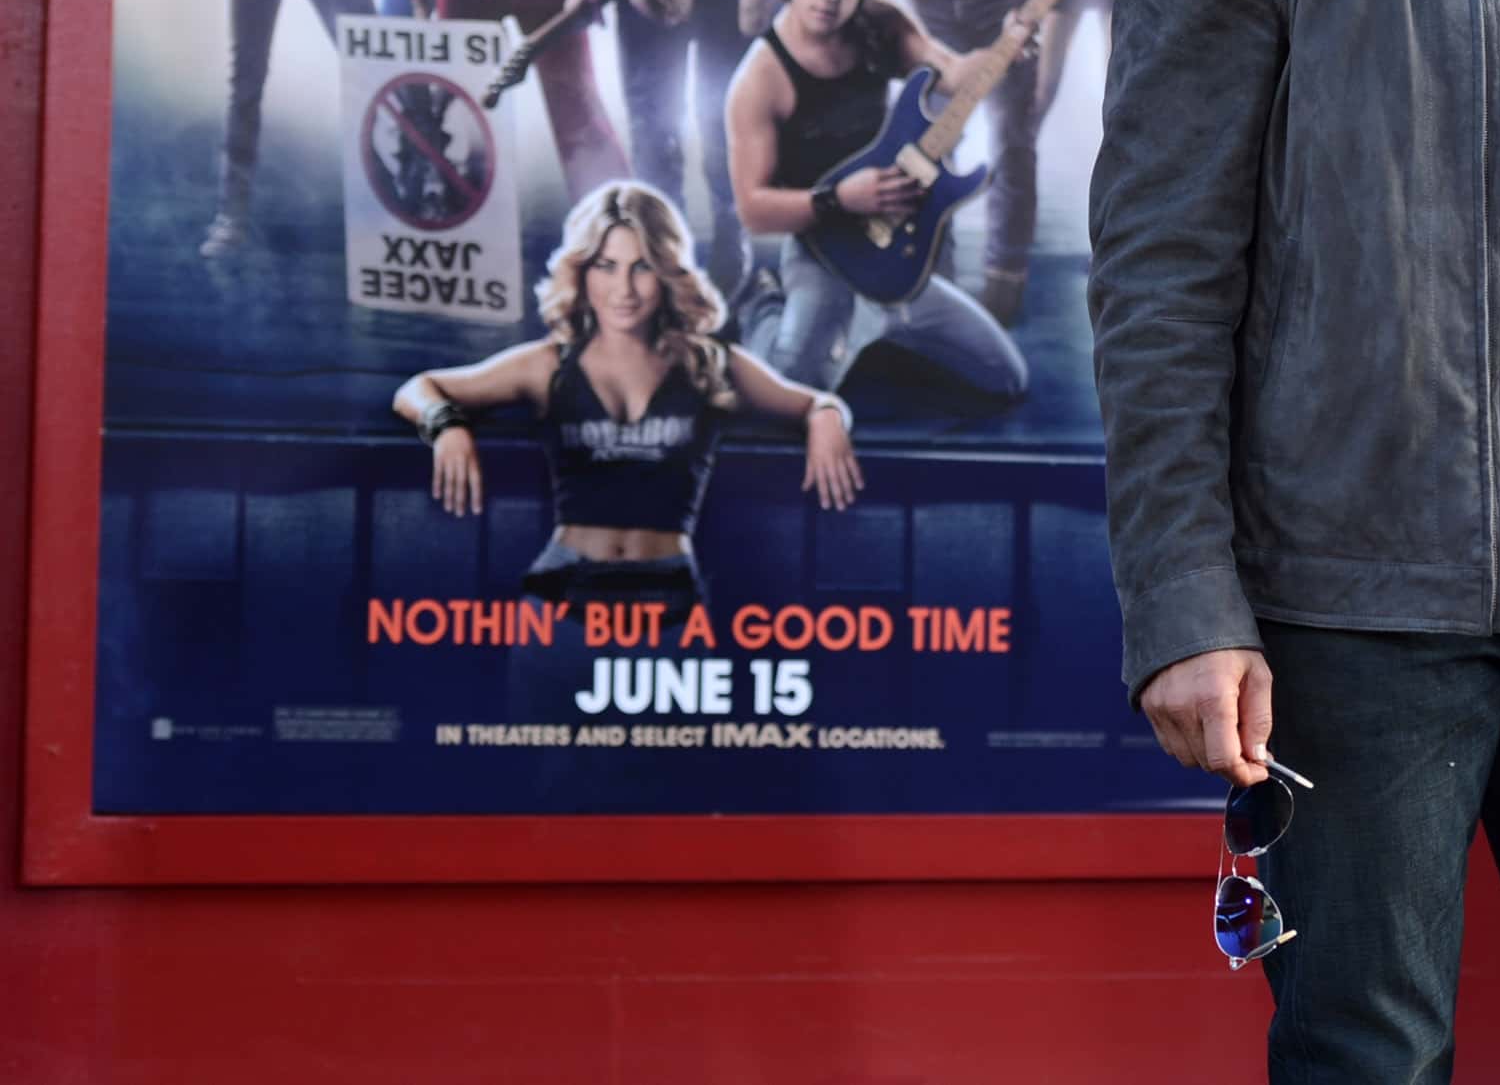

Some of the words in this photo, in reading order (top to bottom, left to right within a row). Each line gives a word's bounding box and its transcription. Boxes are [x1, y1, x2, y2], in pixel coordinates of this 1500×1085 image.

[346, 27, 451, 62] FILTH
[465, 34, 500, 64] IS
[380, 234, 482, 271] JAXX
[359, 267, 508, 312] STACEE
[585, 602, 666, 648] BUT
[679, 603, 716, 649] A
[731, 603, 893, 652] GOOD
[908, 606, 1011, 653] TIME
[574, 657, 733, 715] JUNE
[749, 658, 814, 716] 15
[435, 725, 463, 746] IN
[467, 725, 571, 746] THEATERS
[575, 726, 627, 747] AND
[631, 726, 706, 748] SELECT
[711, 722, 814, 749] IMAX
[818, 727, 946, 750] LOCATIONS.
